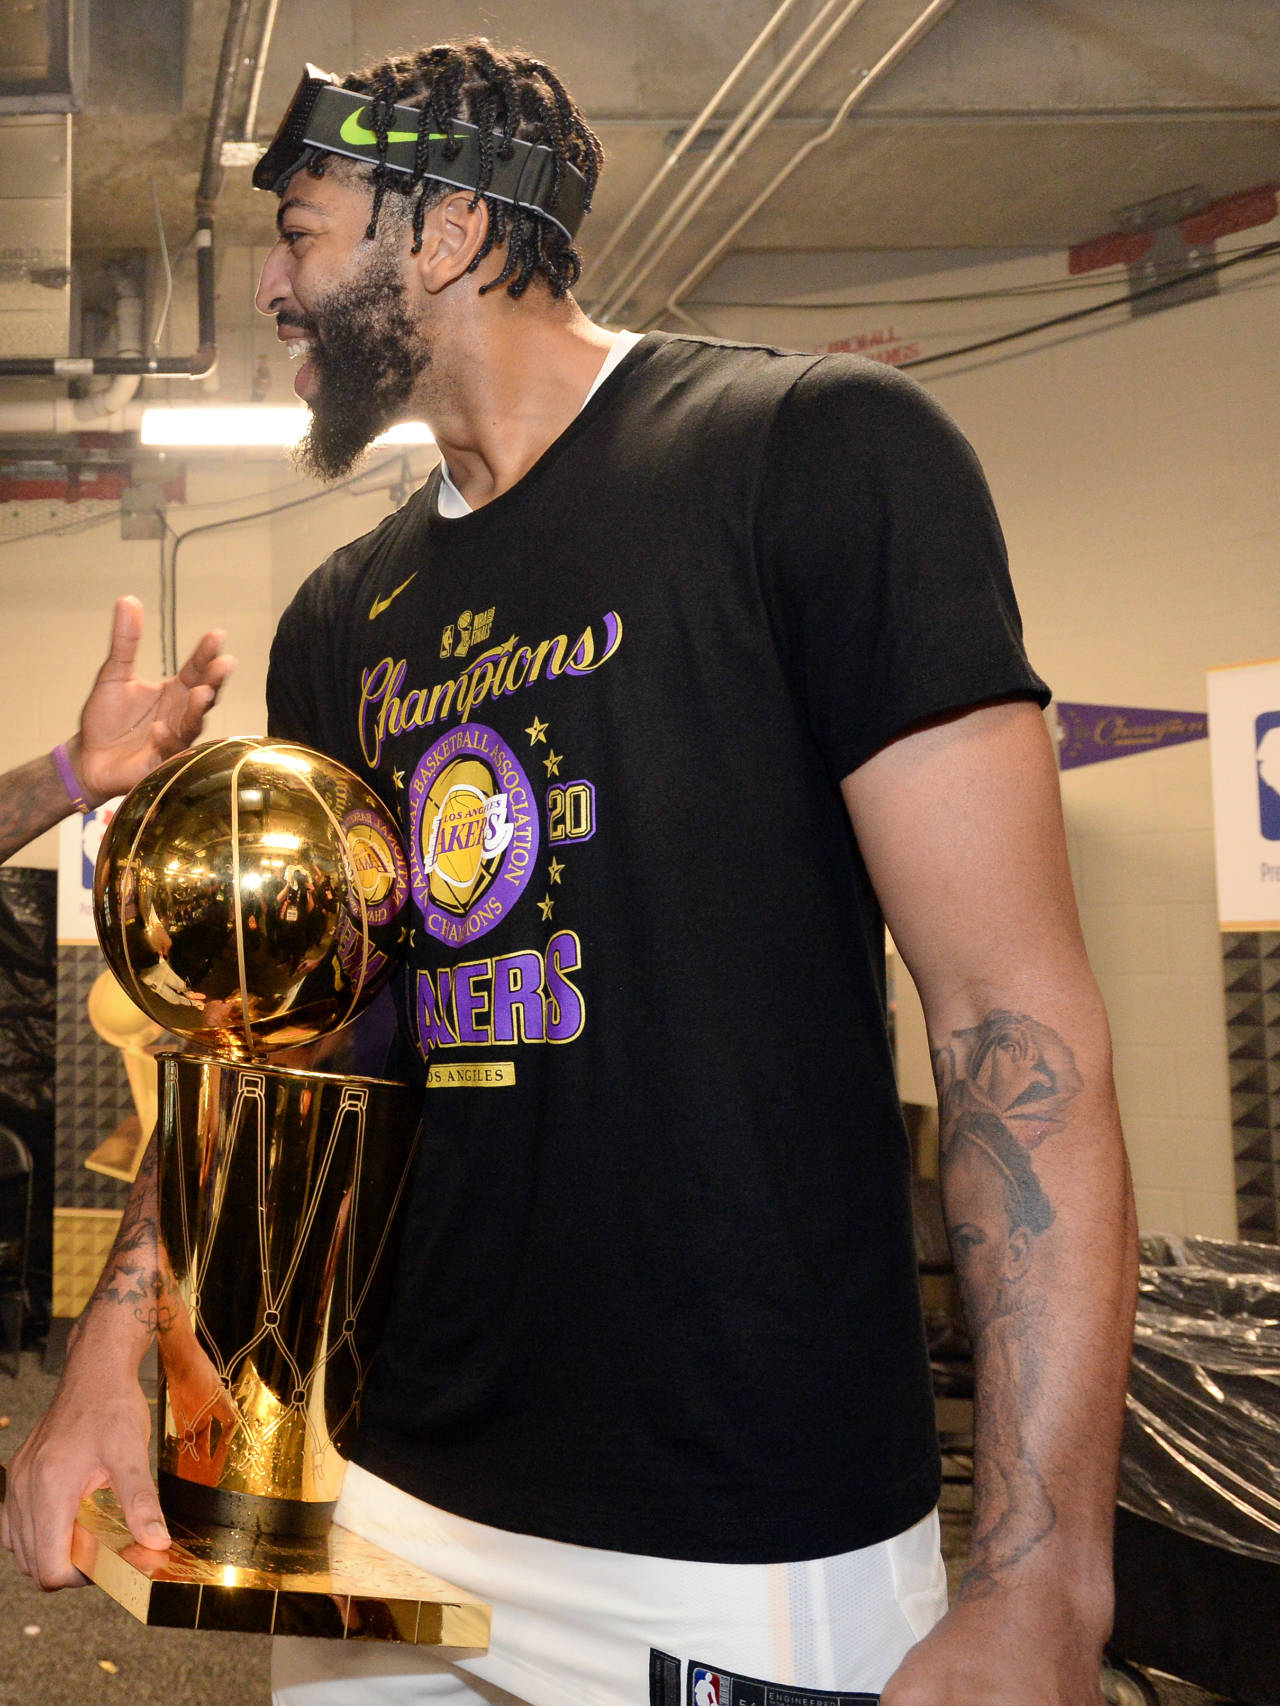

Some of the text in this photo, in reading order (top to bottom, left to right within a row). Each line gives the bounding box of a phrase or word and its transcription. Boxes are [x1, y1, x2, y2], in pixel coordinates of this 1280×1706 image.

[358, 610, 623, 769] Champions
[413, 730, 489, 795] BASKETBALL
[490, 743, 532, 887] ASSOCIATION
[444, 812, 463, 823] LOS
[548, 780, 596, 846] 20
[428, 896, 503, 941] CHAIONS
[428, 1071, 442, 1083] OS
